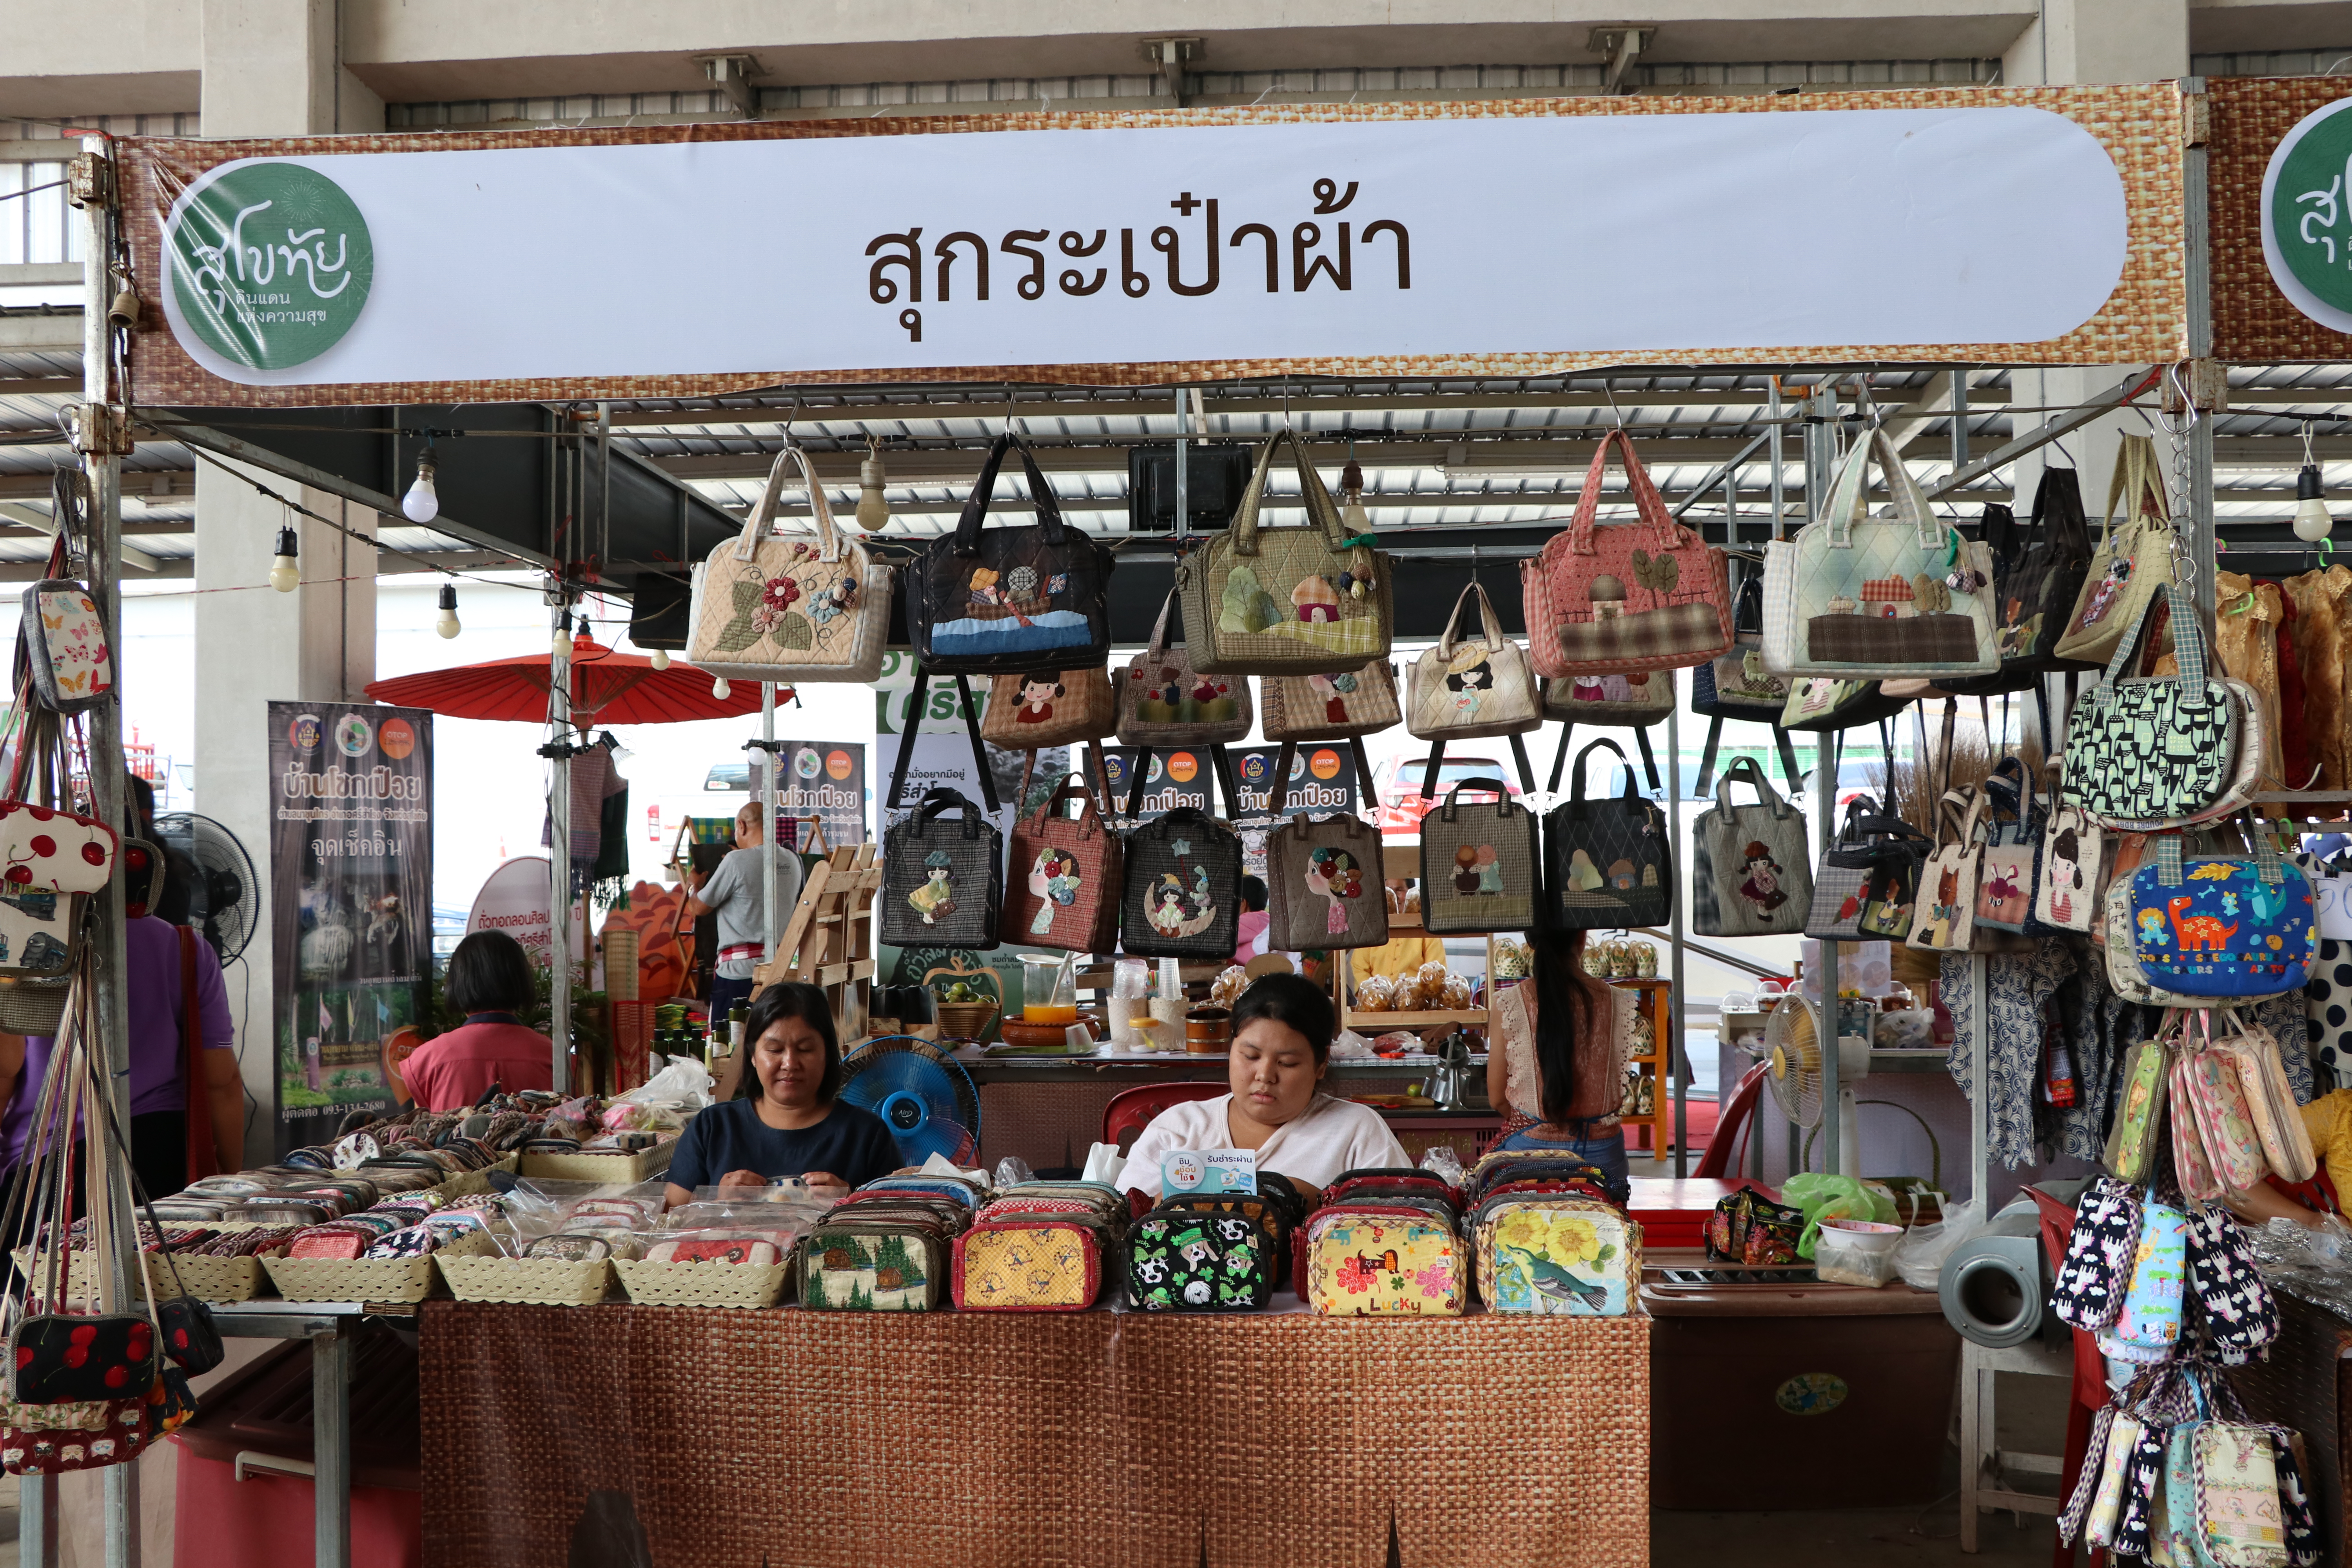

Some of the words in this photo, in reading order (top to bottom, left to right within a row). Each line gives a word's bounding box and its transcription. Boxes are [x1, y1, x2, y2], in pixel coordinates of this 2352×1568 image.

[864, 178, 1411, 343] สุกระเป๋าผ้า
[311, 829, 402, 866] จุดเช็คอิน
[2196, 952, 2280, 962] STEGOSAURUS
[1207, 1154, 1252, 1163] รับชำระผ่าน
[1134, 1239, 1151, 1249] lucky
[1219, 1275, 1236, 1286] lucky
